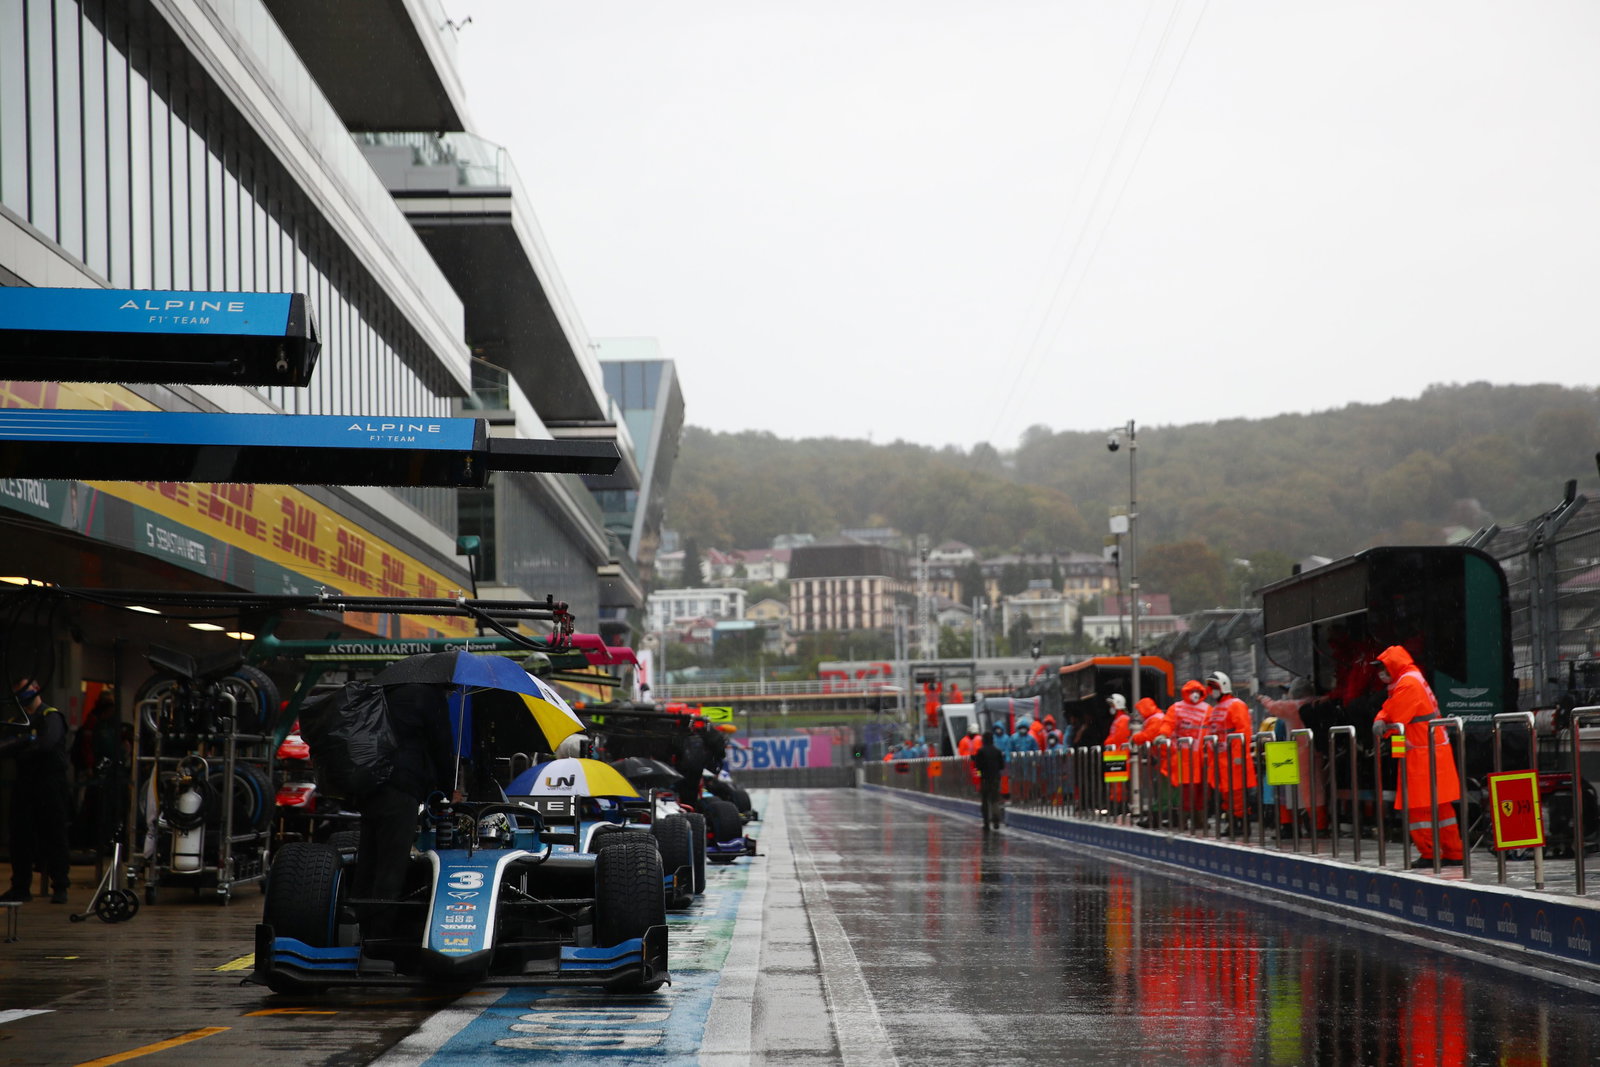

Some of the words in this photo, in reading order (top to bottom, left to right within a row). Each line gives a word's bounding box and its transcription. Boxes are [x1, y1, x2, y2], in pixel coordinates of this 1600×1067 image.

[120, 299, 246, 312] ALPINE
[174, 316, 210, 325] TEAM
[347, 423, 441, 433] ALPINE
[16, 478, 50, 509] STROLL
[146, 522, 154, 548] 5
[328, 643, 375, 654] ASTON
[378, 643, 431, 653] MARTIN
[751, 738, 808, 768] BWT
[448, 871, 484, 889] 3
